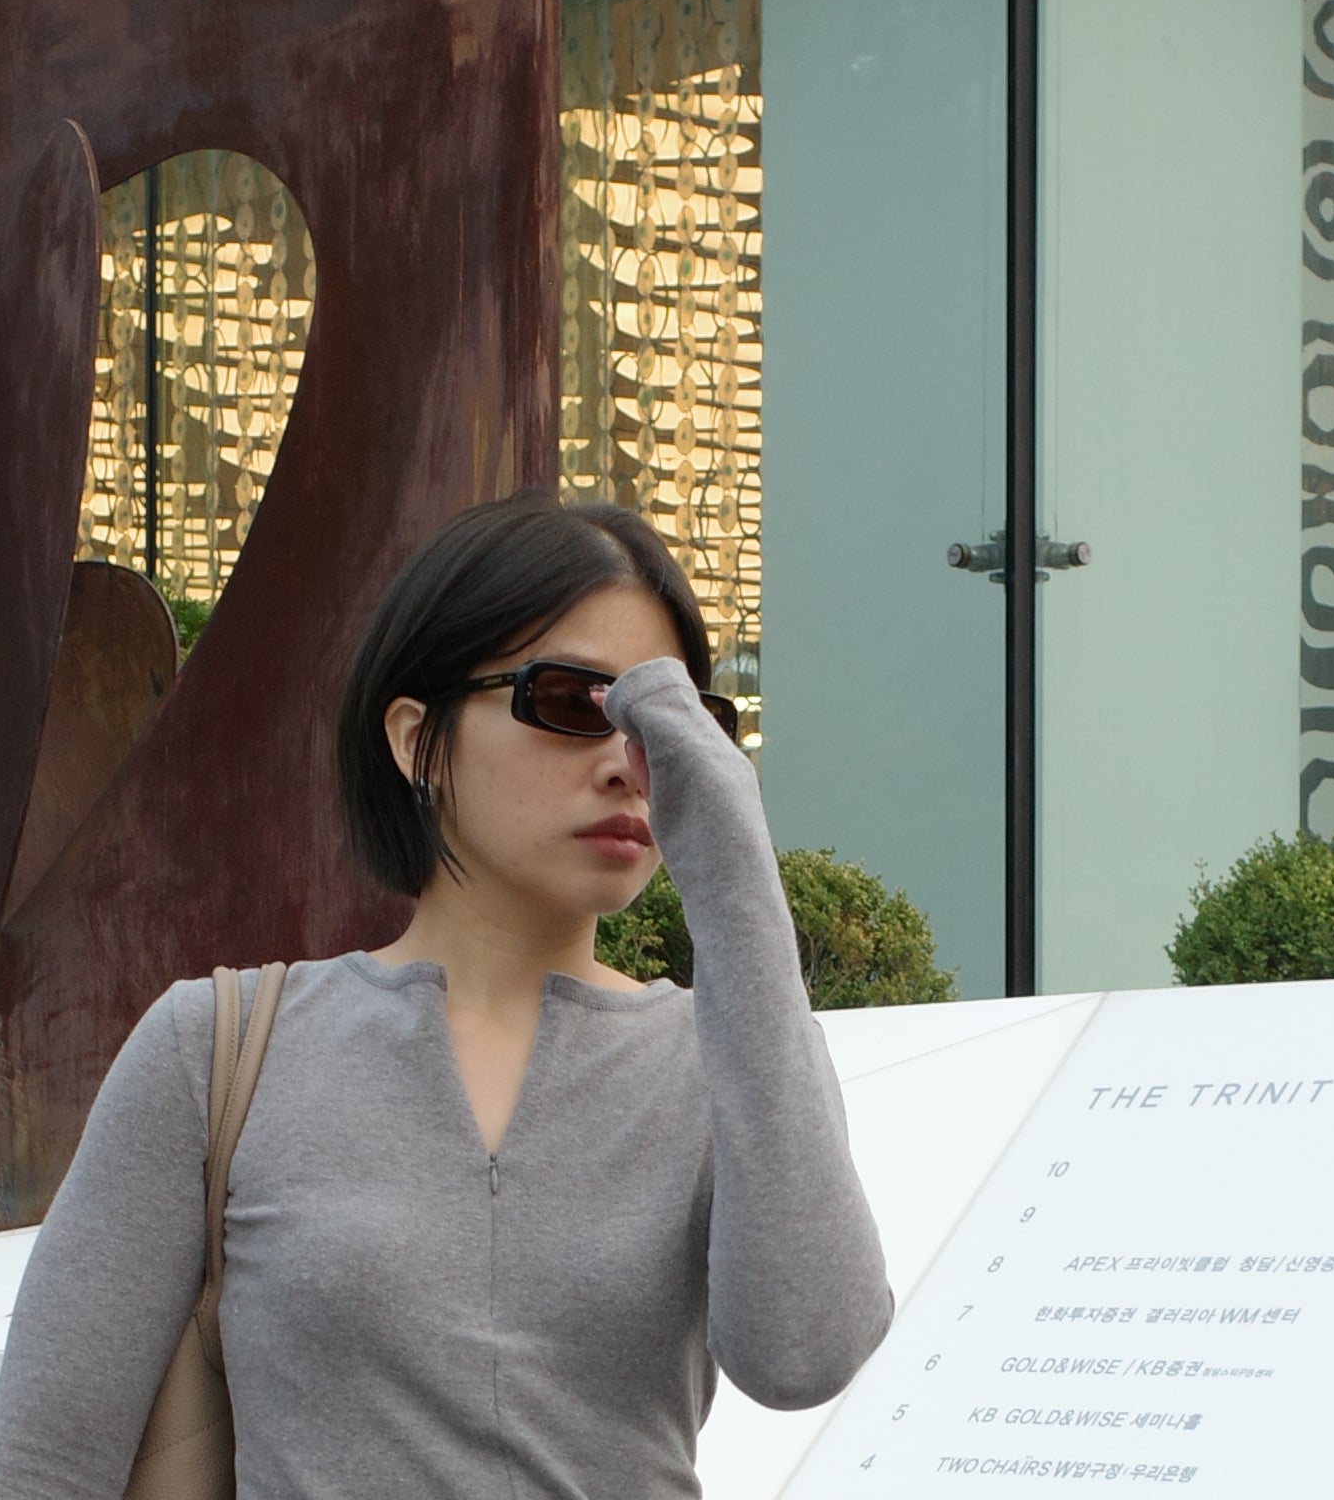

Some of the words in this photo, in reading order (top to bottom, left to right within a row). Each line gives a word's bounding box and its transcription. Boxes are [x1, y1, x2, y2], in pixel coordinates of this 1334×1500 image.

[1086, 1085, 1169, 1111] THE
[1045, 1160, 1070, 1179] 10
[1018, 1205, 1036, 1225] 9
[986, 1255, 1004, 1274] 8
[1063, 1255, 1123, 1273] APEX
[955, 1304, 973, 1324] 7
[1033, 1305, 1138, 1324] 한화투자증권
[923, 1353, 941, 1372] 6
[999, 1356, 1123, 1375] GOLD&WISE
[891, 1404, 908, 1423] 5
[966, 1406, 998, 1424] KB
[1004, 1408, 1129, 1429] GOLD&WISE
[859, 1453, 877, 1472] 4
[935, 1456, 979, 1475] TWO
